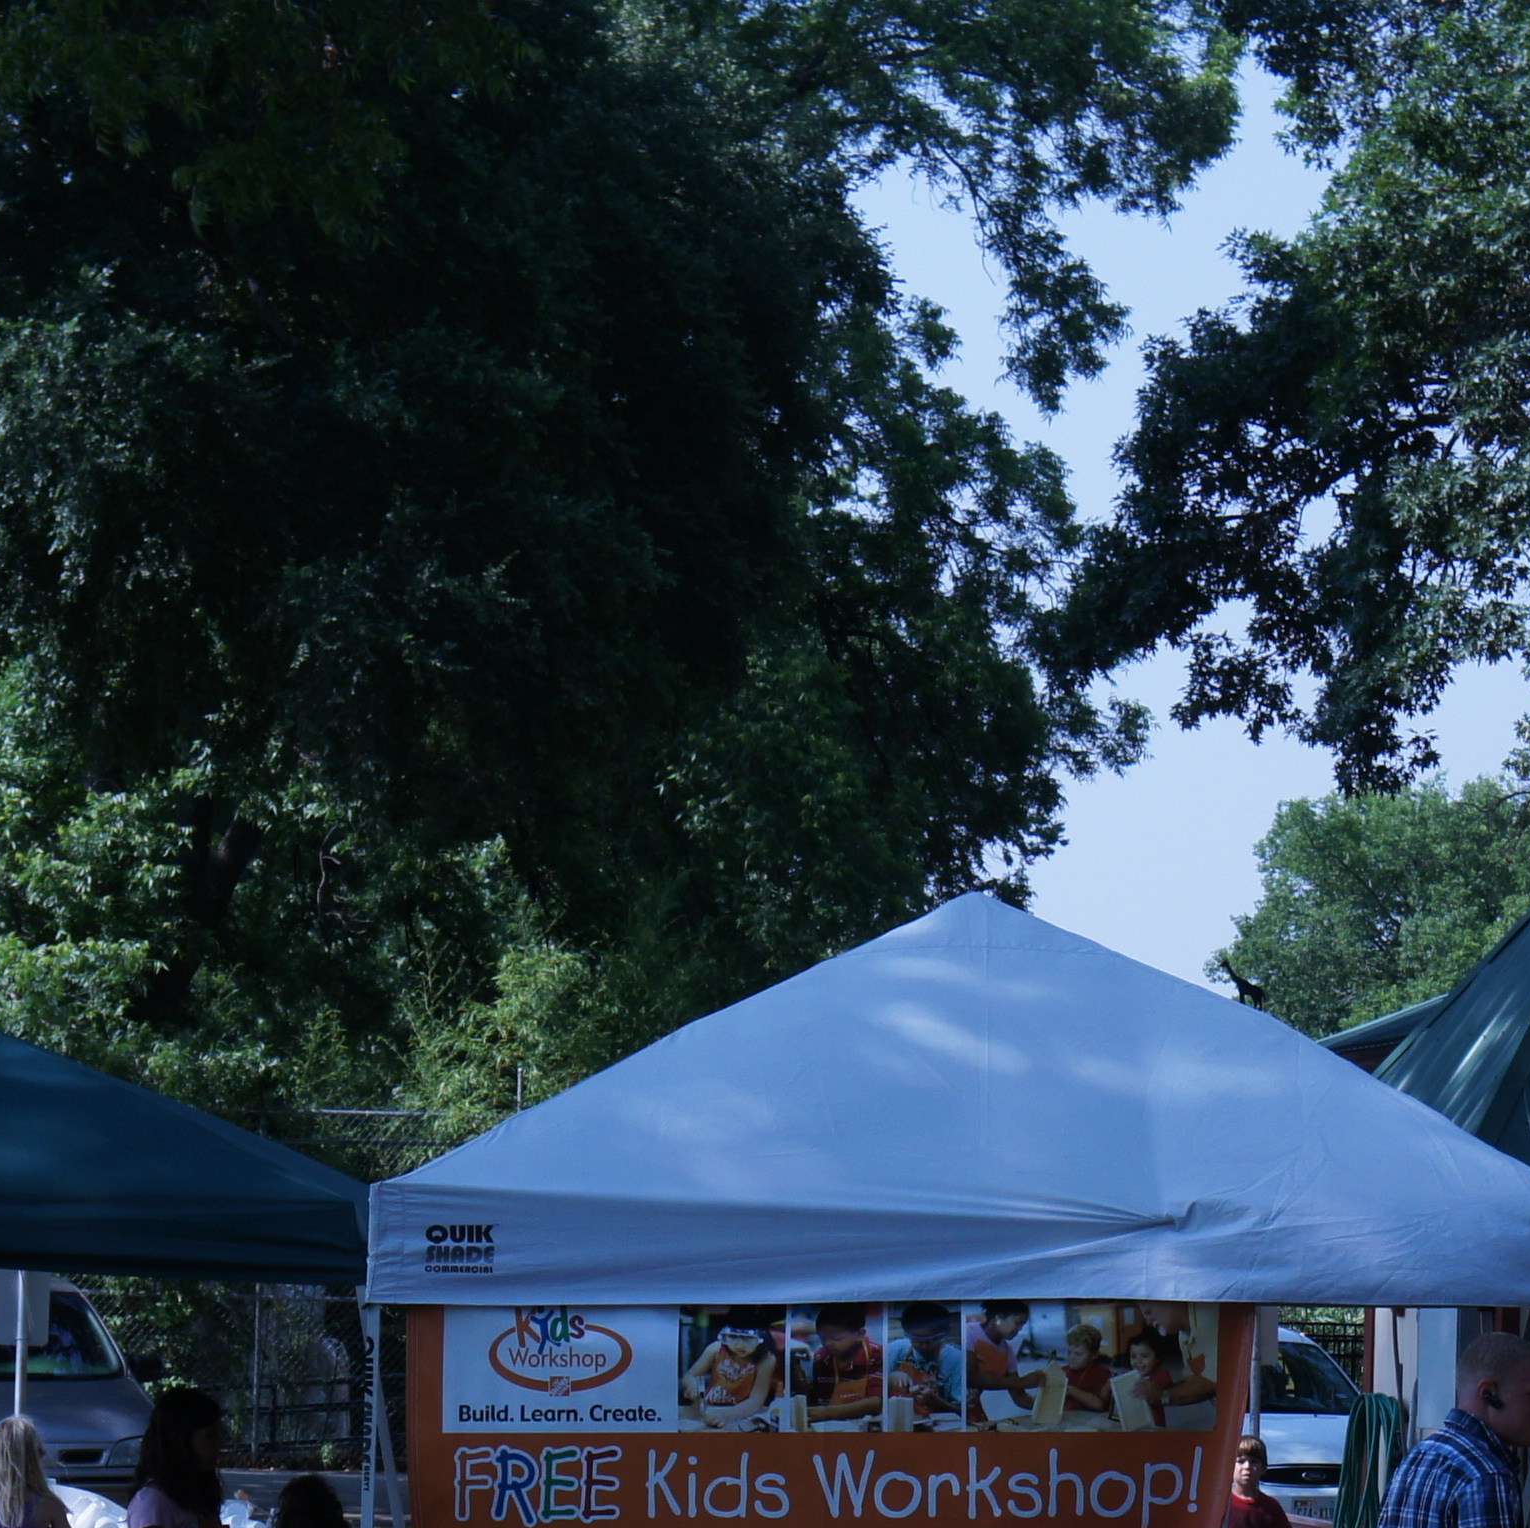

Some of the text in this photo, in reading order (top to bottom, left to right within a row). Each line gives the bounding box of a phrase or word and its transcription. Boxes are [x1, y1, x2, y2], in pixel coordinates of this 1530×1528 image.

[425, 1224, 494, 1244] QUIK
[425, 1245, 495, 1264] SHADE
[508, 1346, 607, 1373] Workshop
[458, 1404, 662, 1423] Build. Learn. Create.
[454, 1444, 622, 1528] FREE
[645, 1449, 791, 1519] Kids
